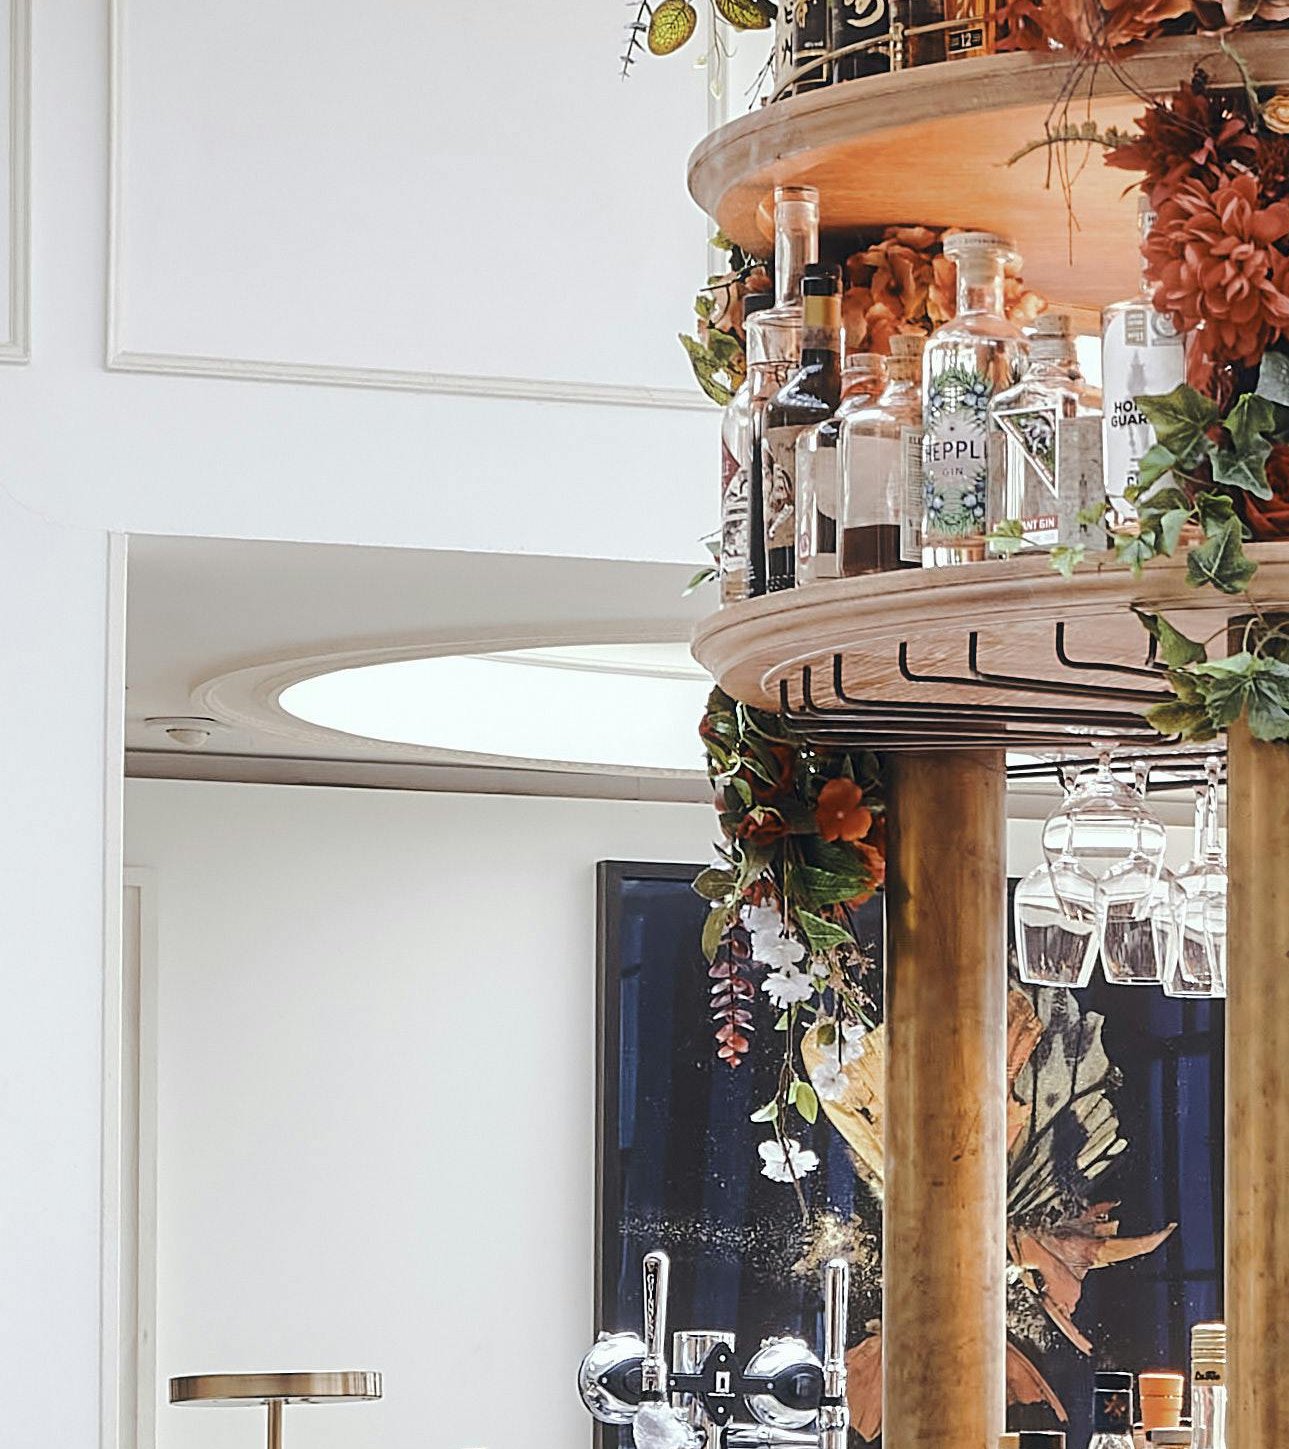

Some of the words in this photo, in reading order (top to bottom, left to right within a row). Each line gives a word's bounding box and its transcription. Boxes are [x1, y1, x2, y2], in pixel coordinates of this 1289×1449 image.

[960, 31, 973, 48] 12
[1111, 412, 1148, 428] GUAR
[942, 466, 964, 477] GIN
[1038, 516, 1056, 530] GIN
